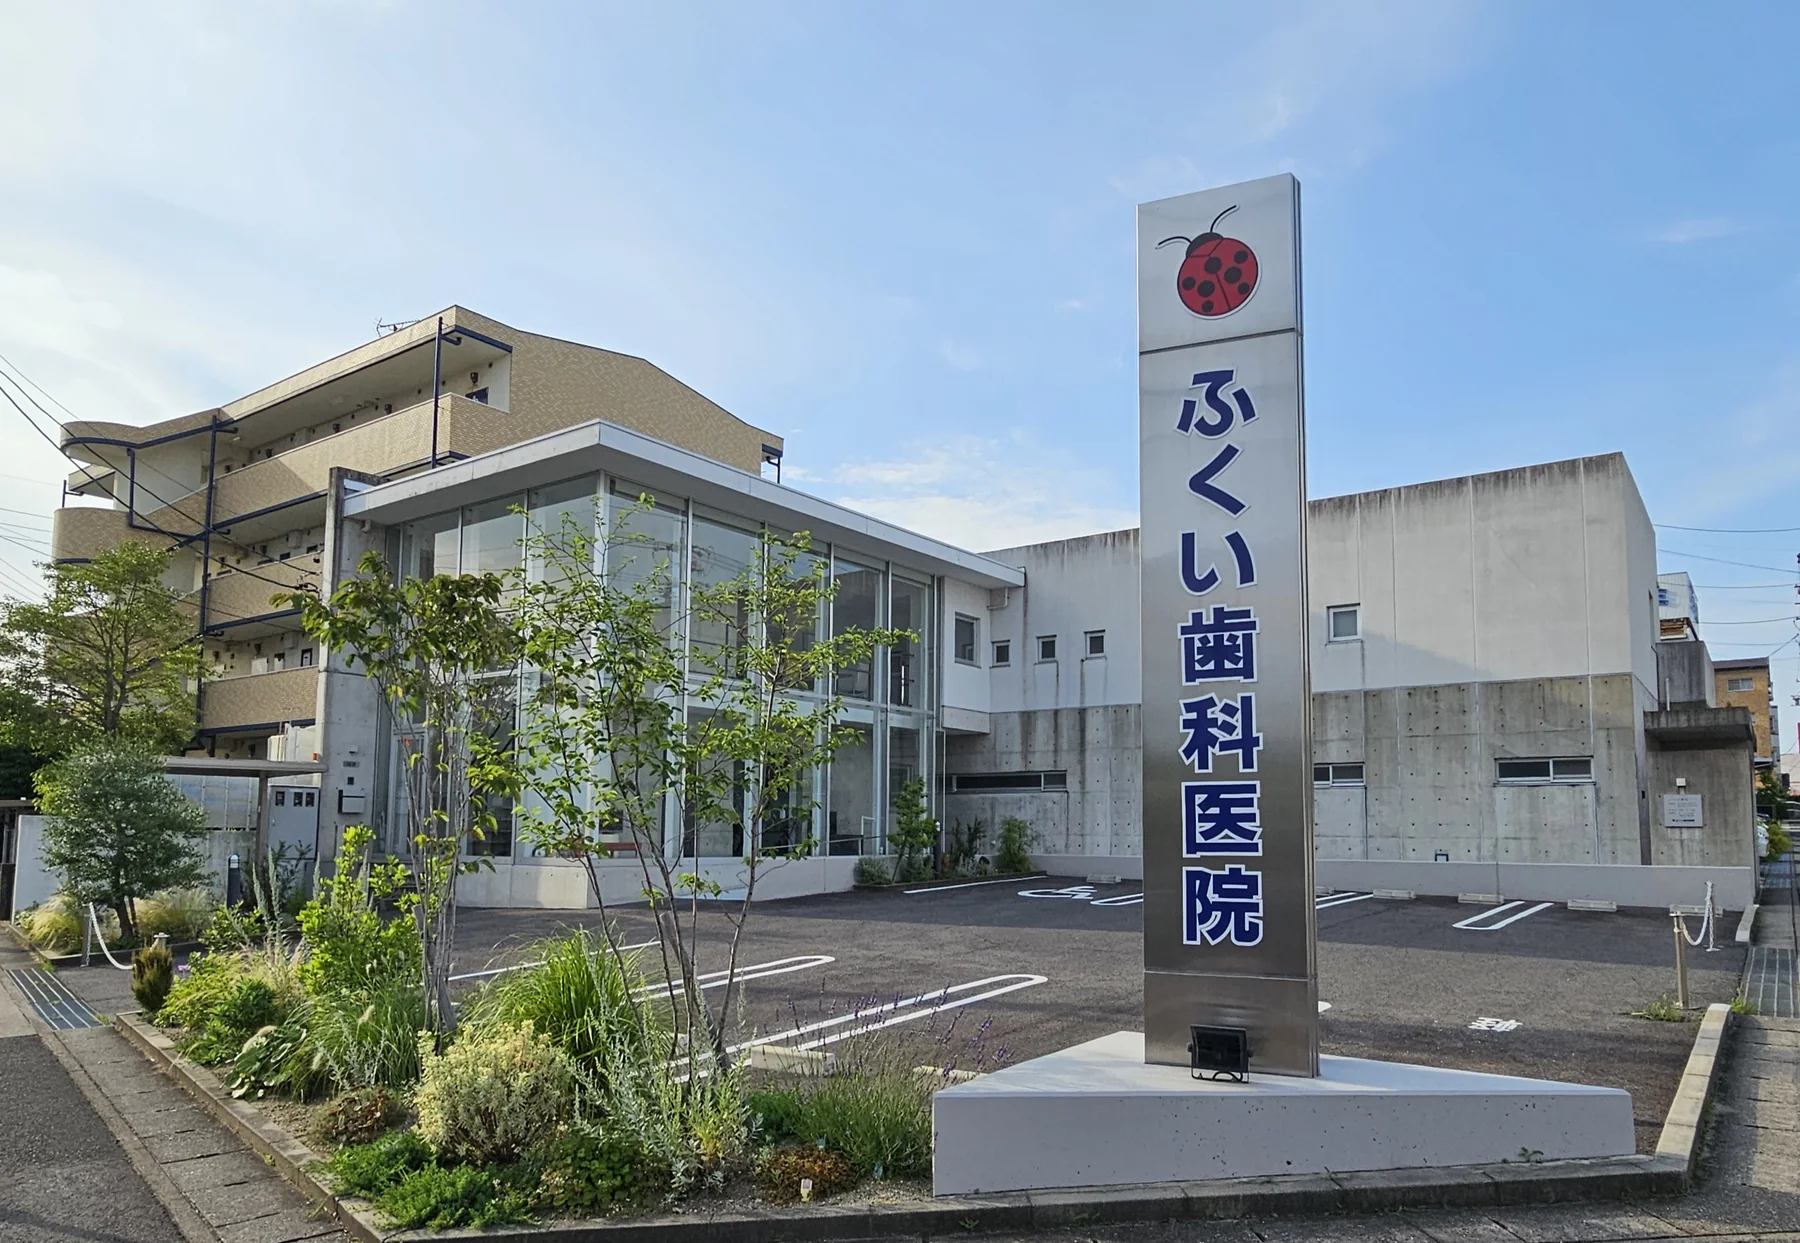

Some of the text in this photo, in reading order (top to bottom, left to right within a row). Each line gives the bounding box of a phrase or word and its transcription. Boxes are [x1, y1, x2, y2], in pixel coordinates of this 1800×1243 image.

[1175, 368, 1264, 948] ふくい歯科医院
